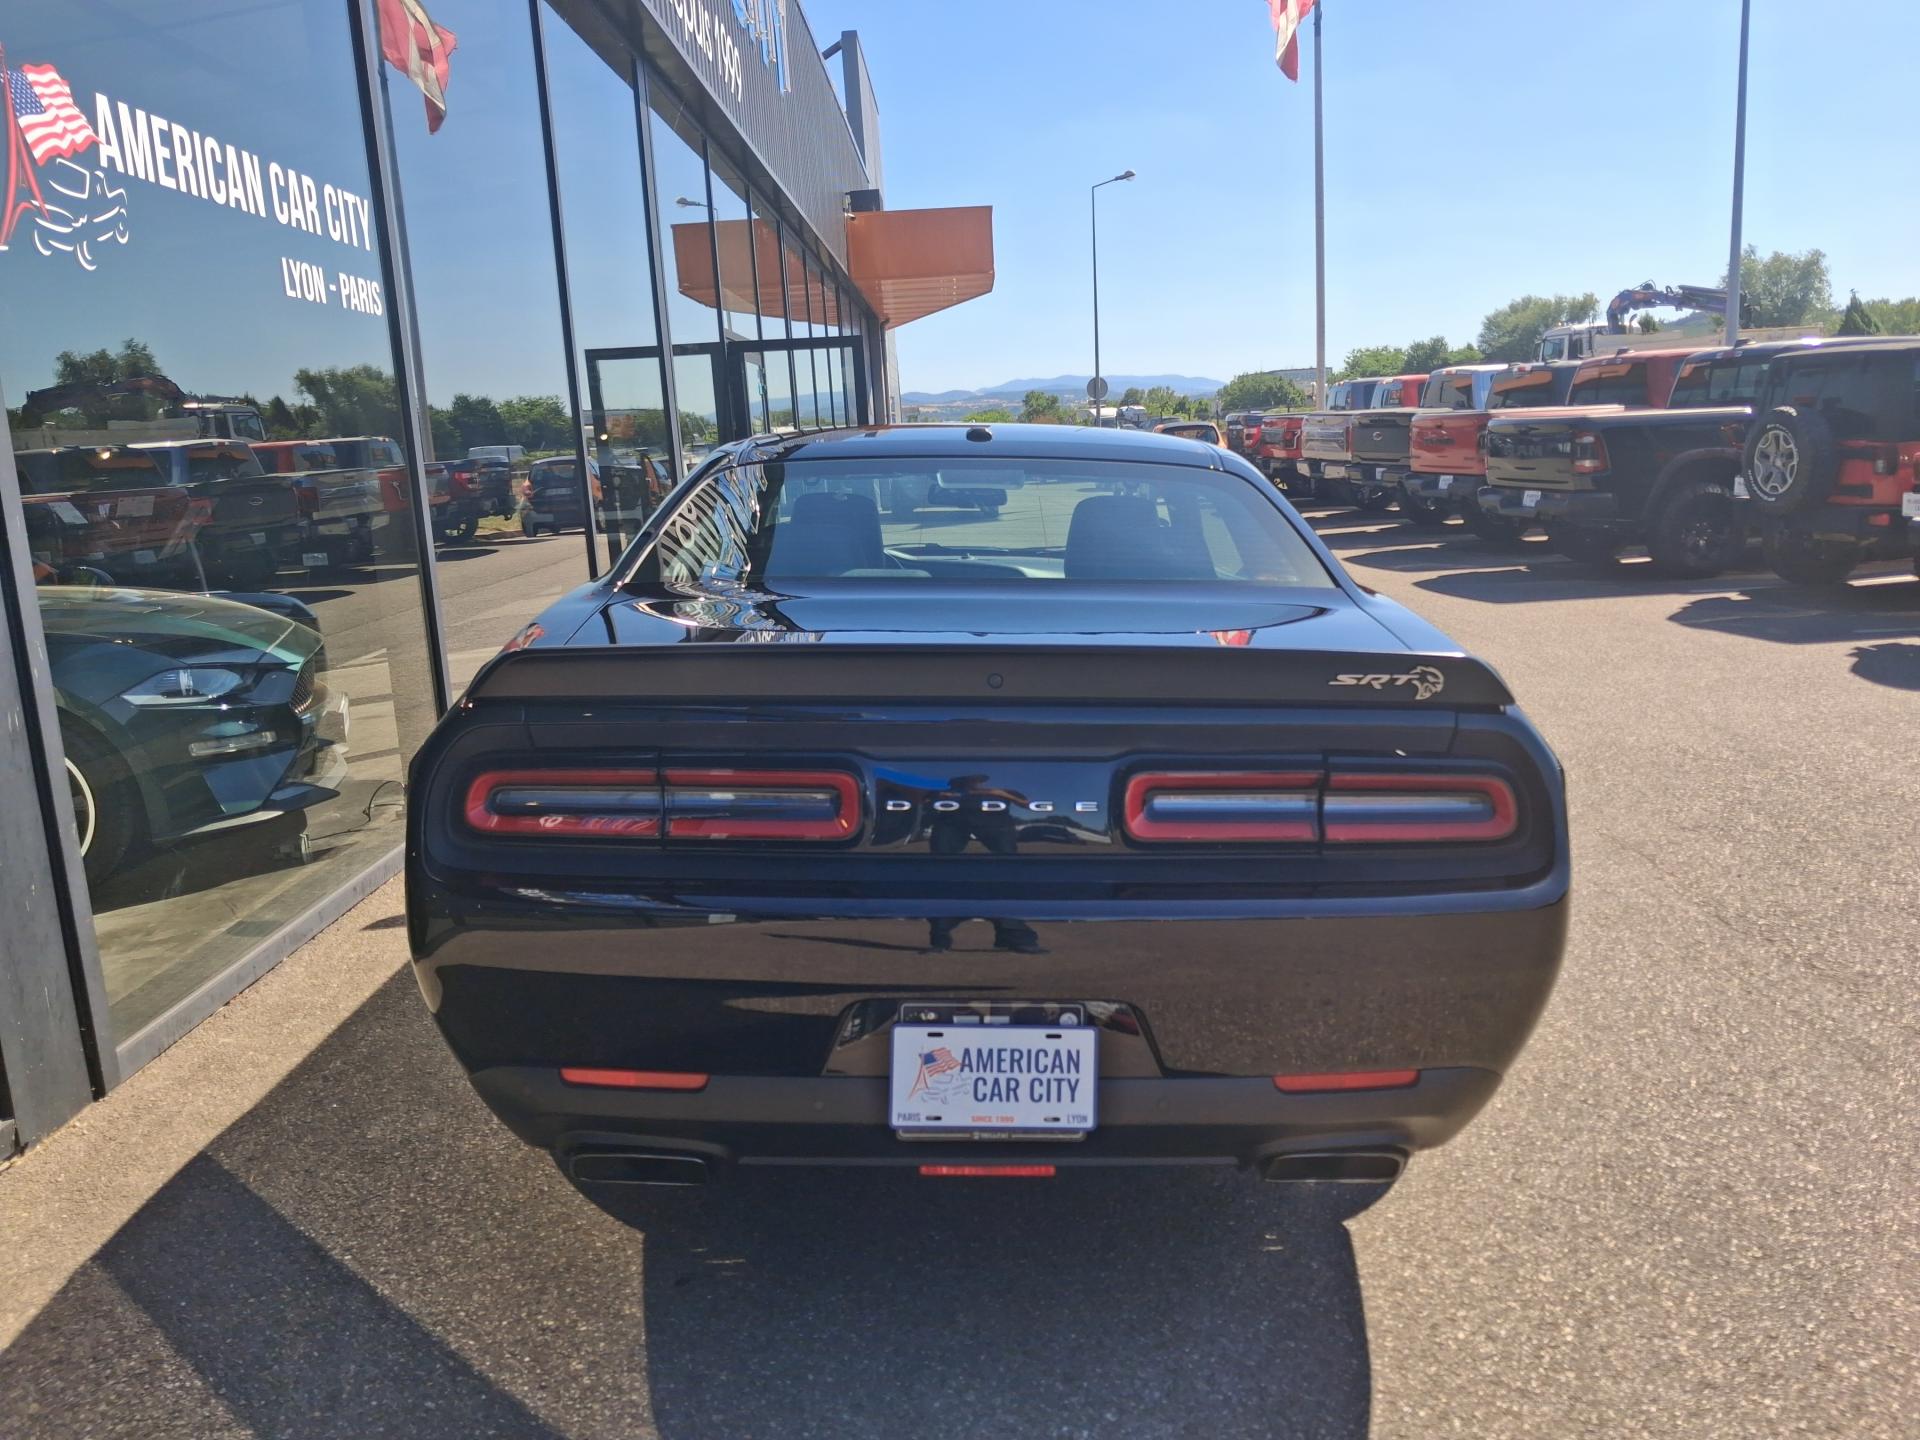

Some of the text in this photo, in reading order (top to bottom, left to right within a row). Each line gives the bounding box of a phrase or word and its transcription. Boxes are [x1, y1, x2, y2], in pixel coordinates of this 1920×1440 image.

[714, 14, 742, 103] 1999
[95, 92, 371, 251] AMERICAN CAR CITY
[281, 257, 326, 304] LYON
[339, 272, 382, 316] PARIS
[1328, 674, 1420, 689] SRT
[886, 800, 1098, 812] DODGE
[960, 1047, 1080, 1074] AMERICAN
[973, 1077, 1080, 1104] CAR CITY
[897, 1112, 921, 1123] PARIS
[1067, 1113, 1088, 1124] LYON
